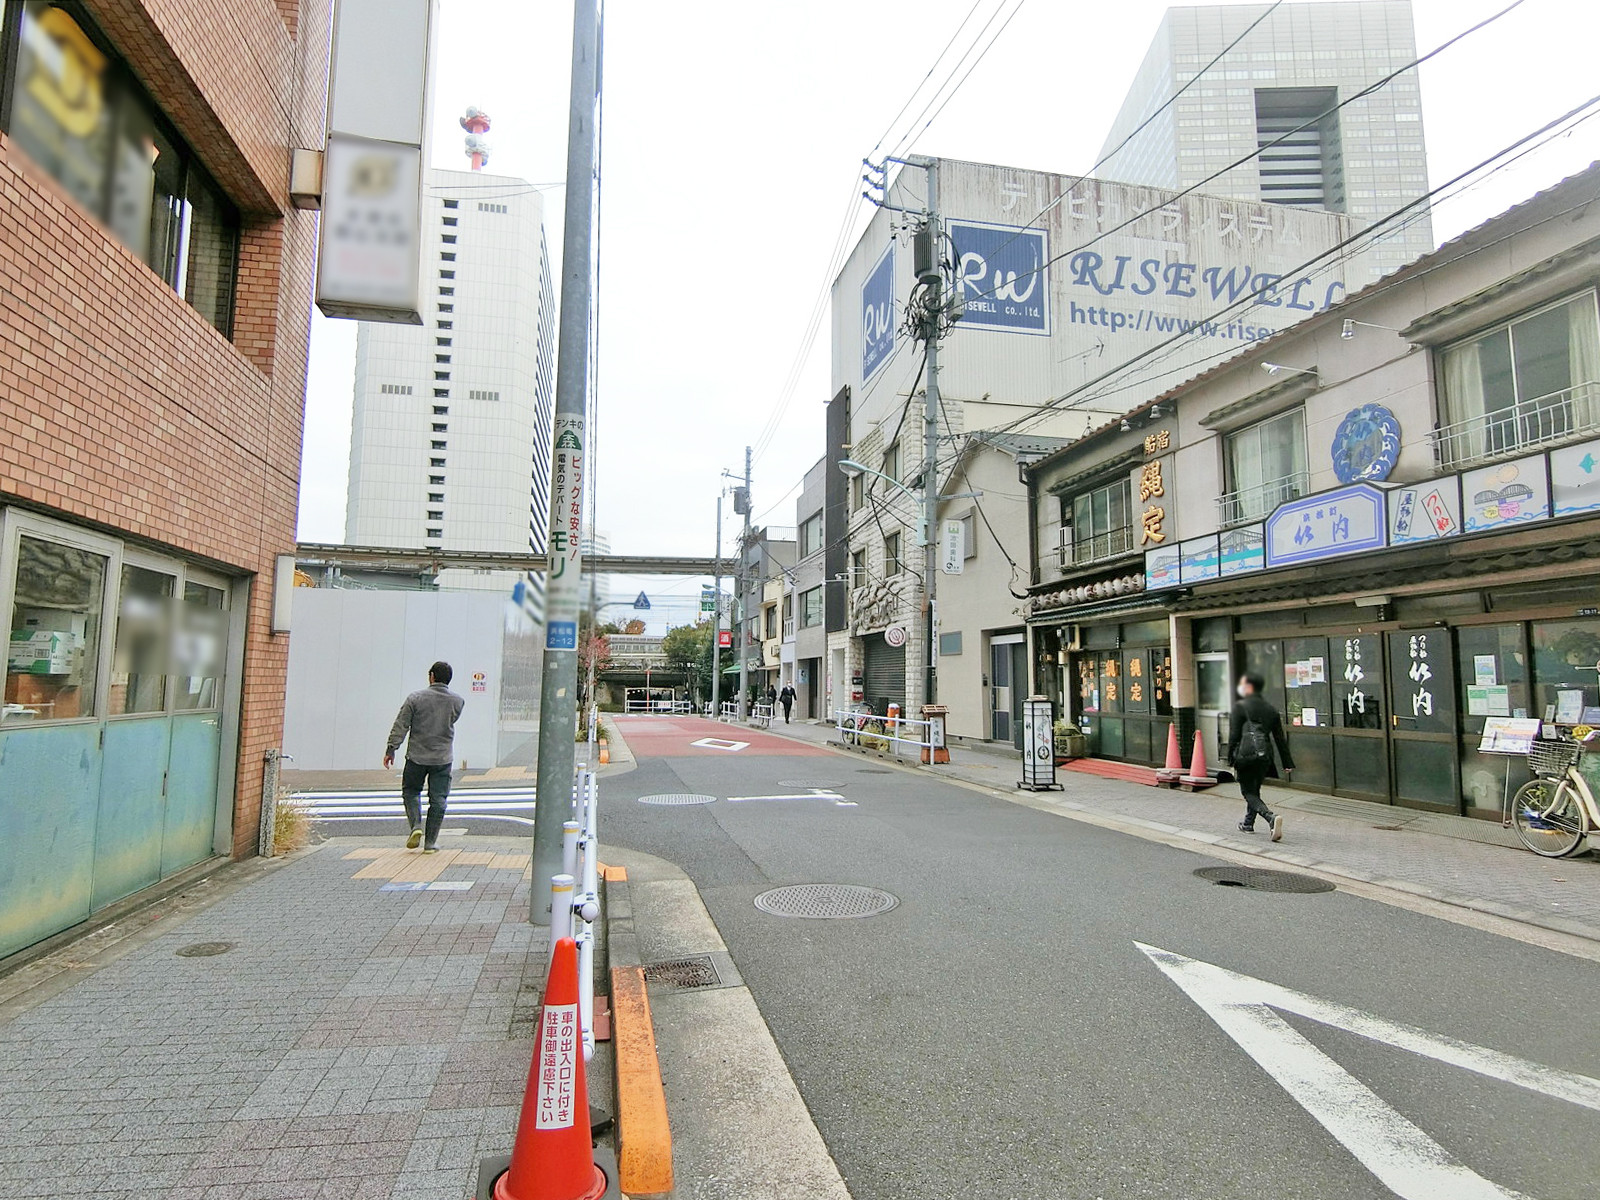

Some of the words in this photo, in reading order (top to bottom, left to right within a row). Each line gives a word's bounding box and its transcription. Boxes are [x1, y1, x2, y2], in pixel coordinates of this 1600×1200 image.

[561, 434, 577, 449] 森
[556, 453, 566, 526] 電気のデパート
[550, 531, 568, 580] モリ
[550, 637, 573, 645] 2-12
[1344, 663, 1365, 715] 竹内
[1409, 660, 1433, 716] 竹内
[541, 1011, 559, 1123] 駐車御遠慮下さい
[557, 1011, 573, 1122] 車の出入口に付き
